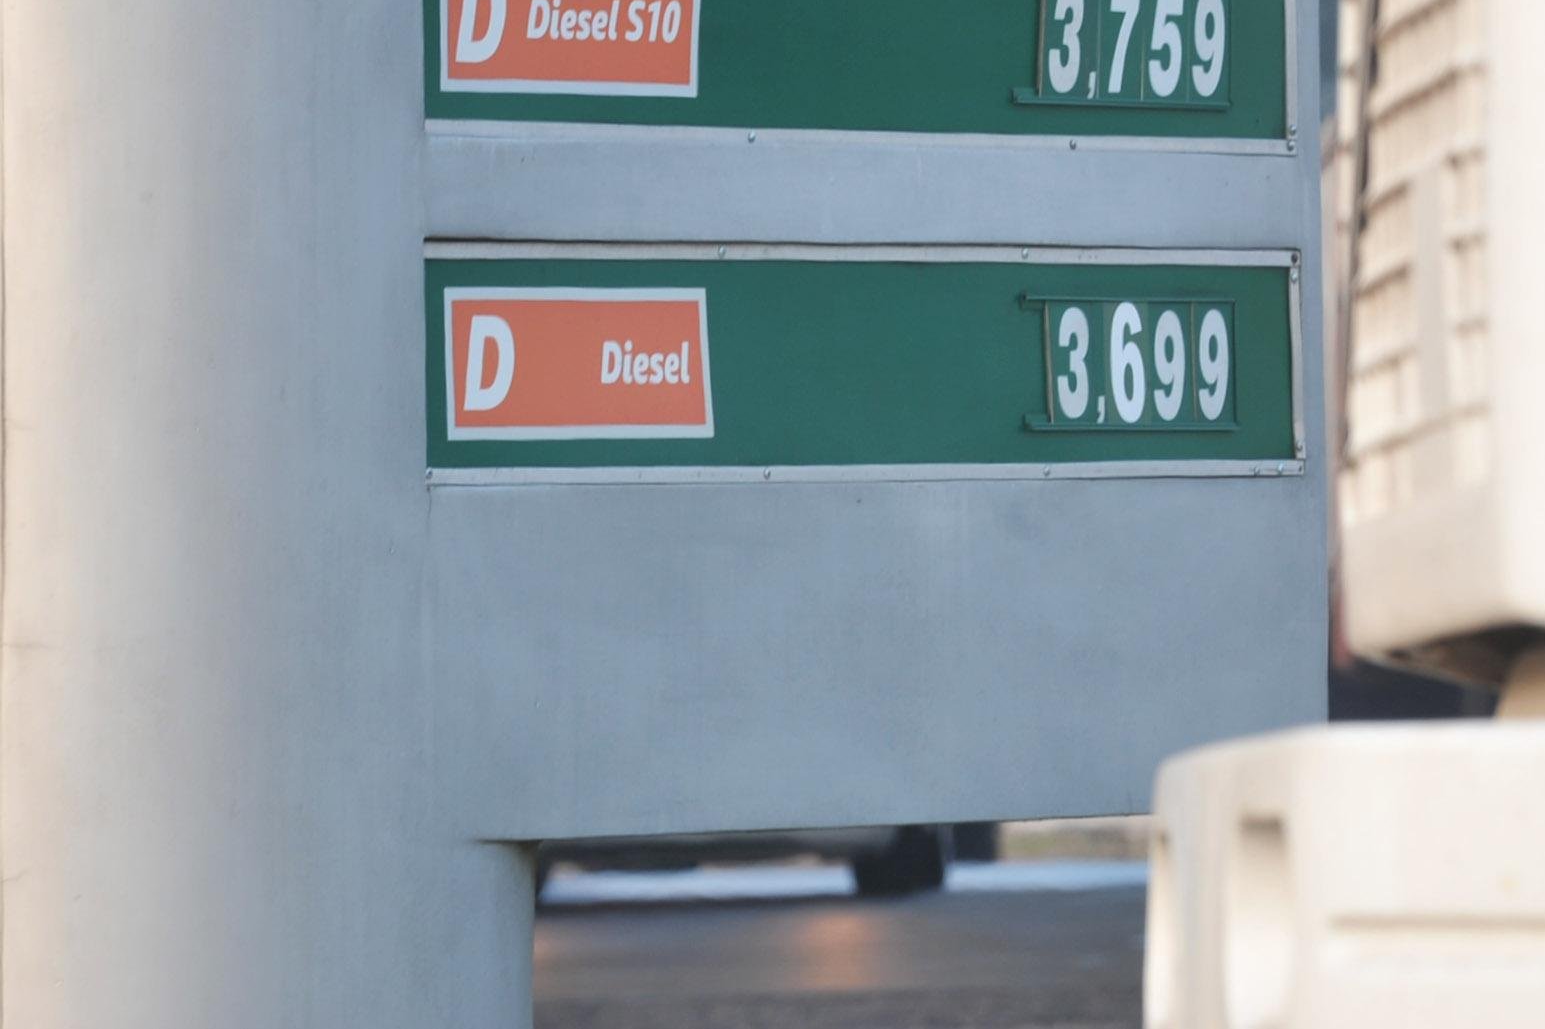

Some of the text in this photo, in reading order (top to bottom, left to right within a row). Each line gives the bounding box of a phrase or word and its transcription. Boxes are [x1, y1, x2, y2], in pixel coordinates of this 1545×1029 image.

[463, 314, 690, 411] D Diesel
[1056, 301, 1230, 424] 3,699
